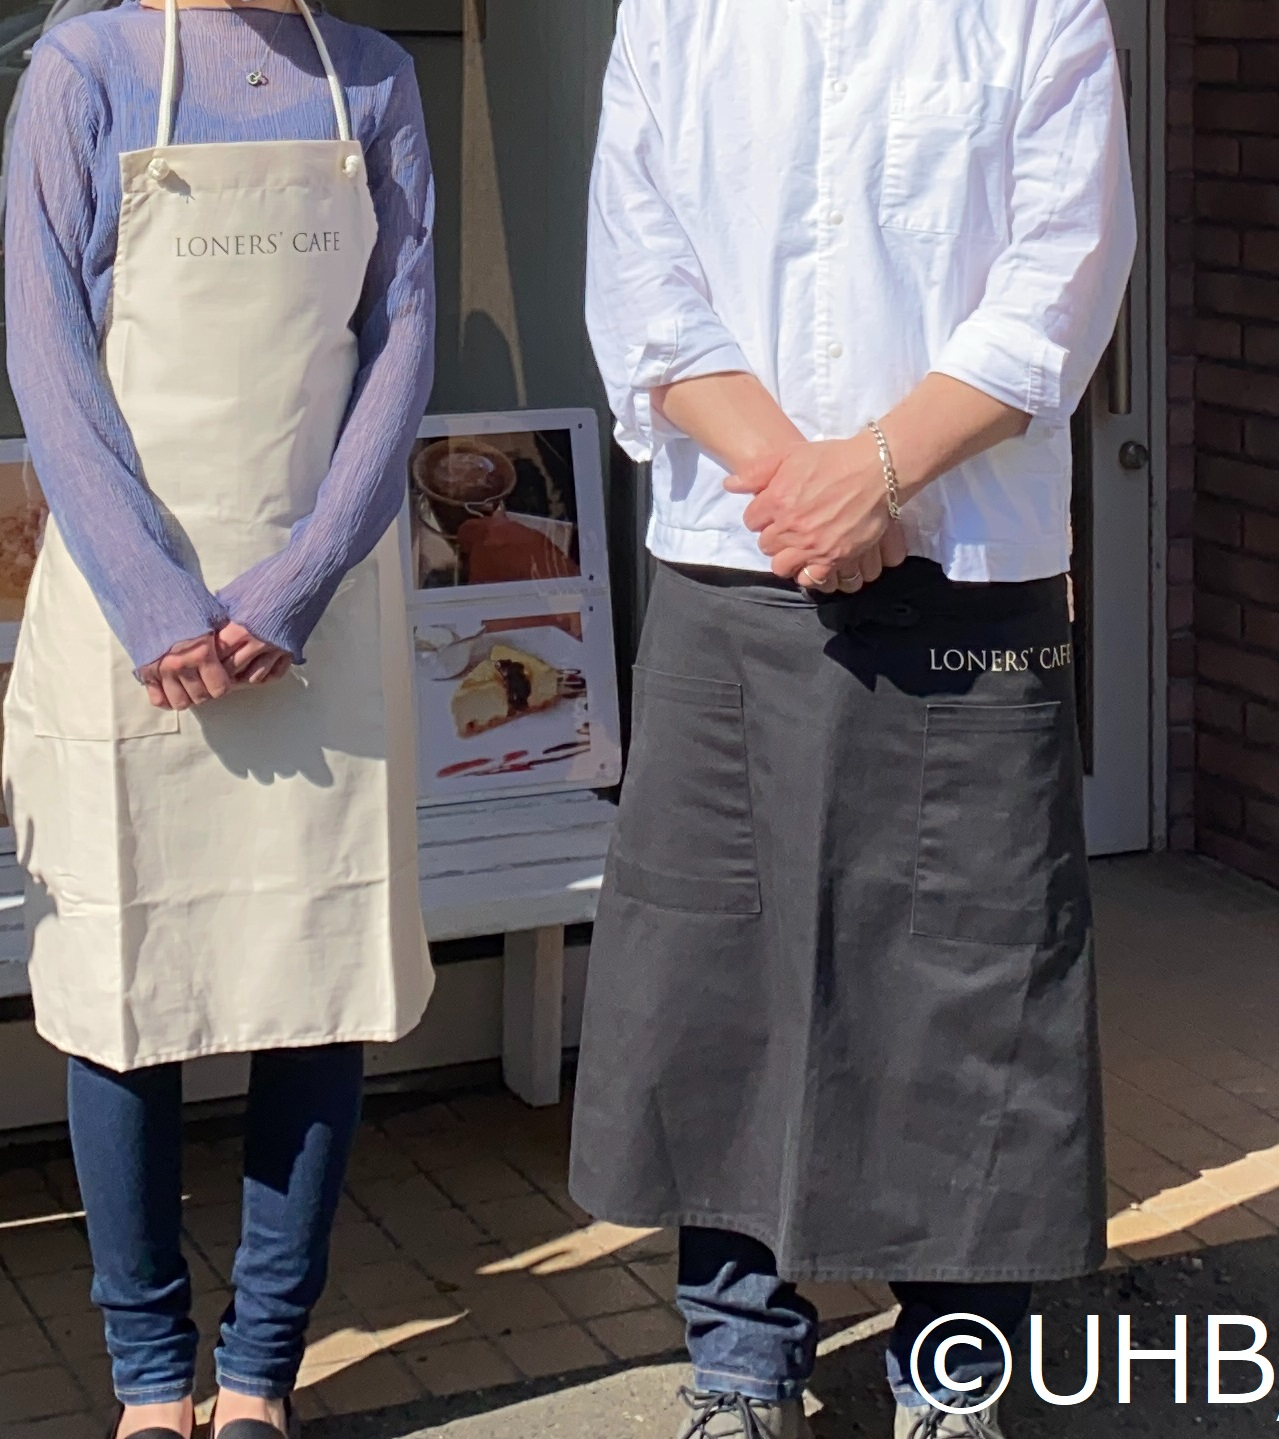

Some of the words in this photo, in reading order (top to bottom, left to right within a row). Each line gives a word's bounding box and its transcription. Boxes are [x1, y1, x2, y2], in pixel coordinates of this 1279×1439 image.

[175, 231, 284, 258] LONERS'
[292, 231, 341, 253] CAFE
[929, 646, 1034, 672] LONERS'
